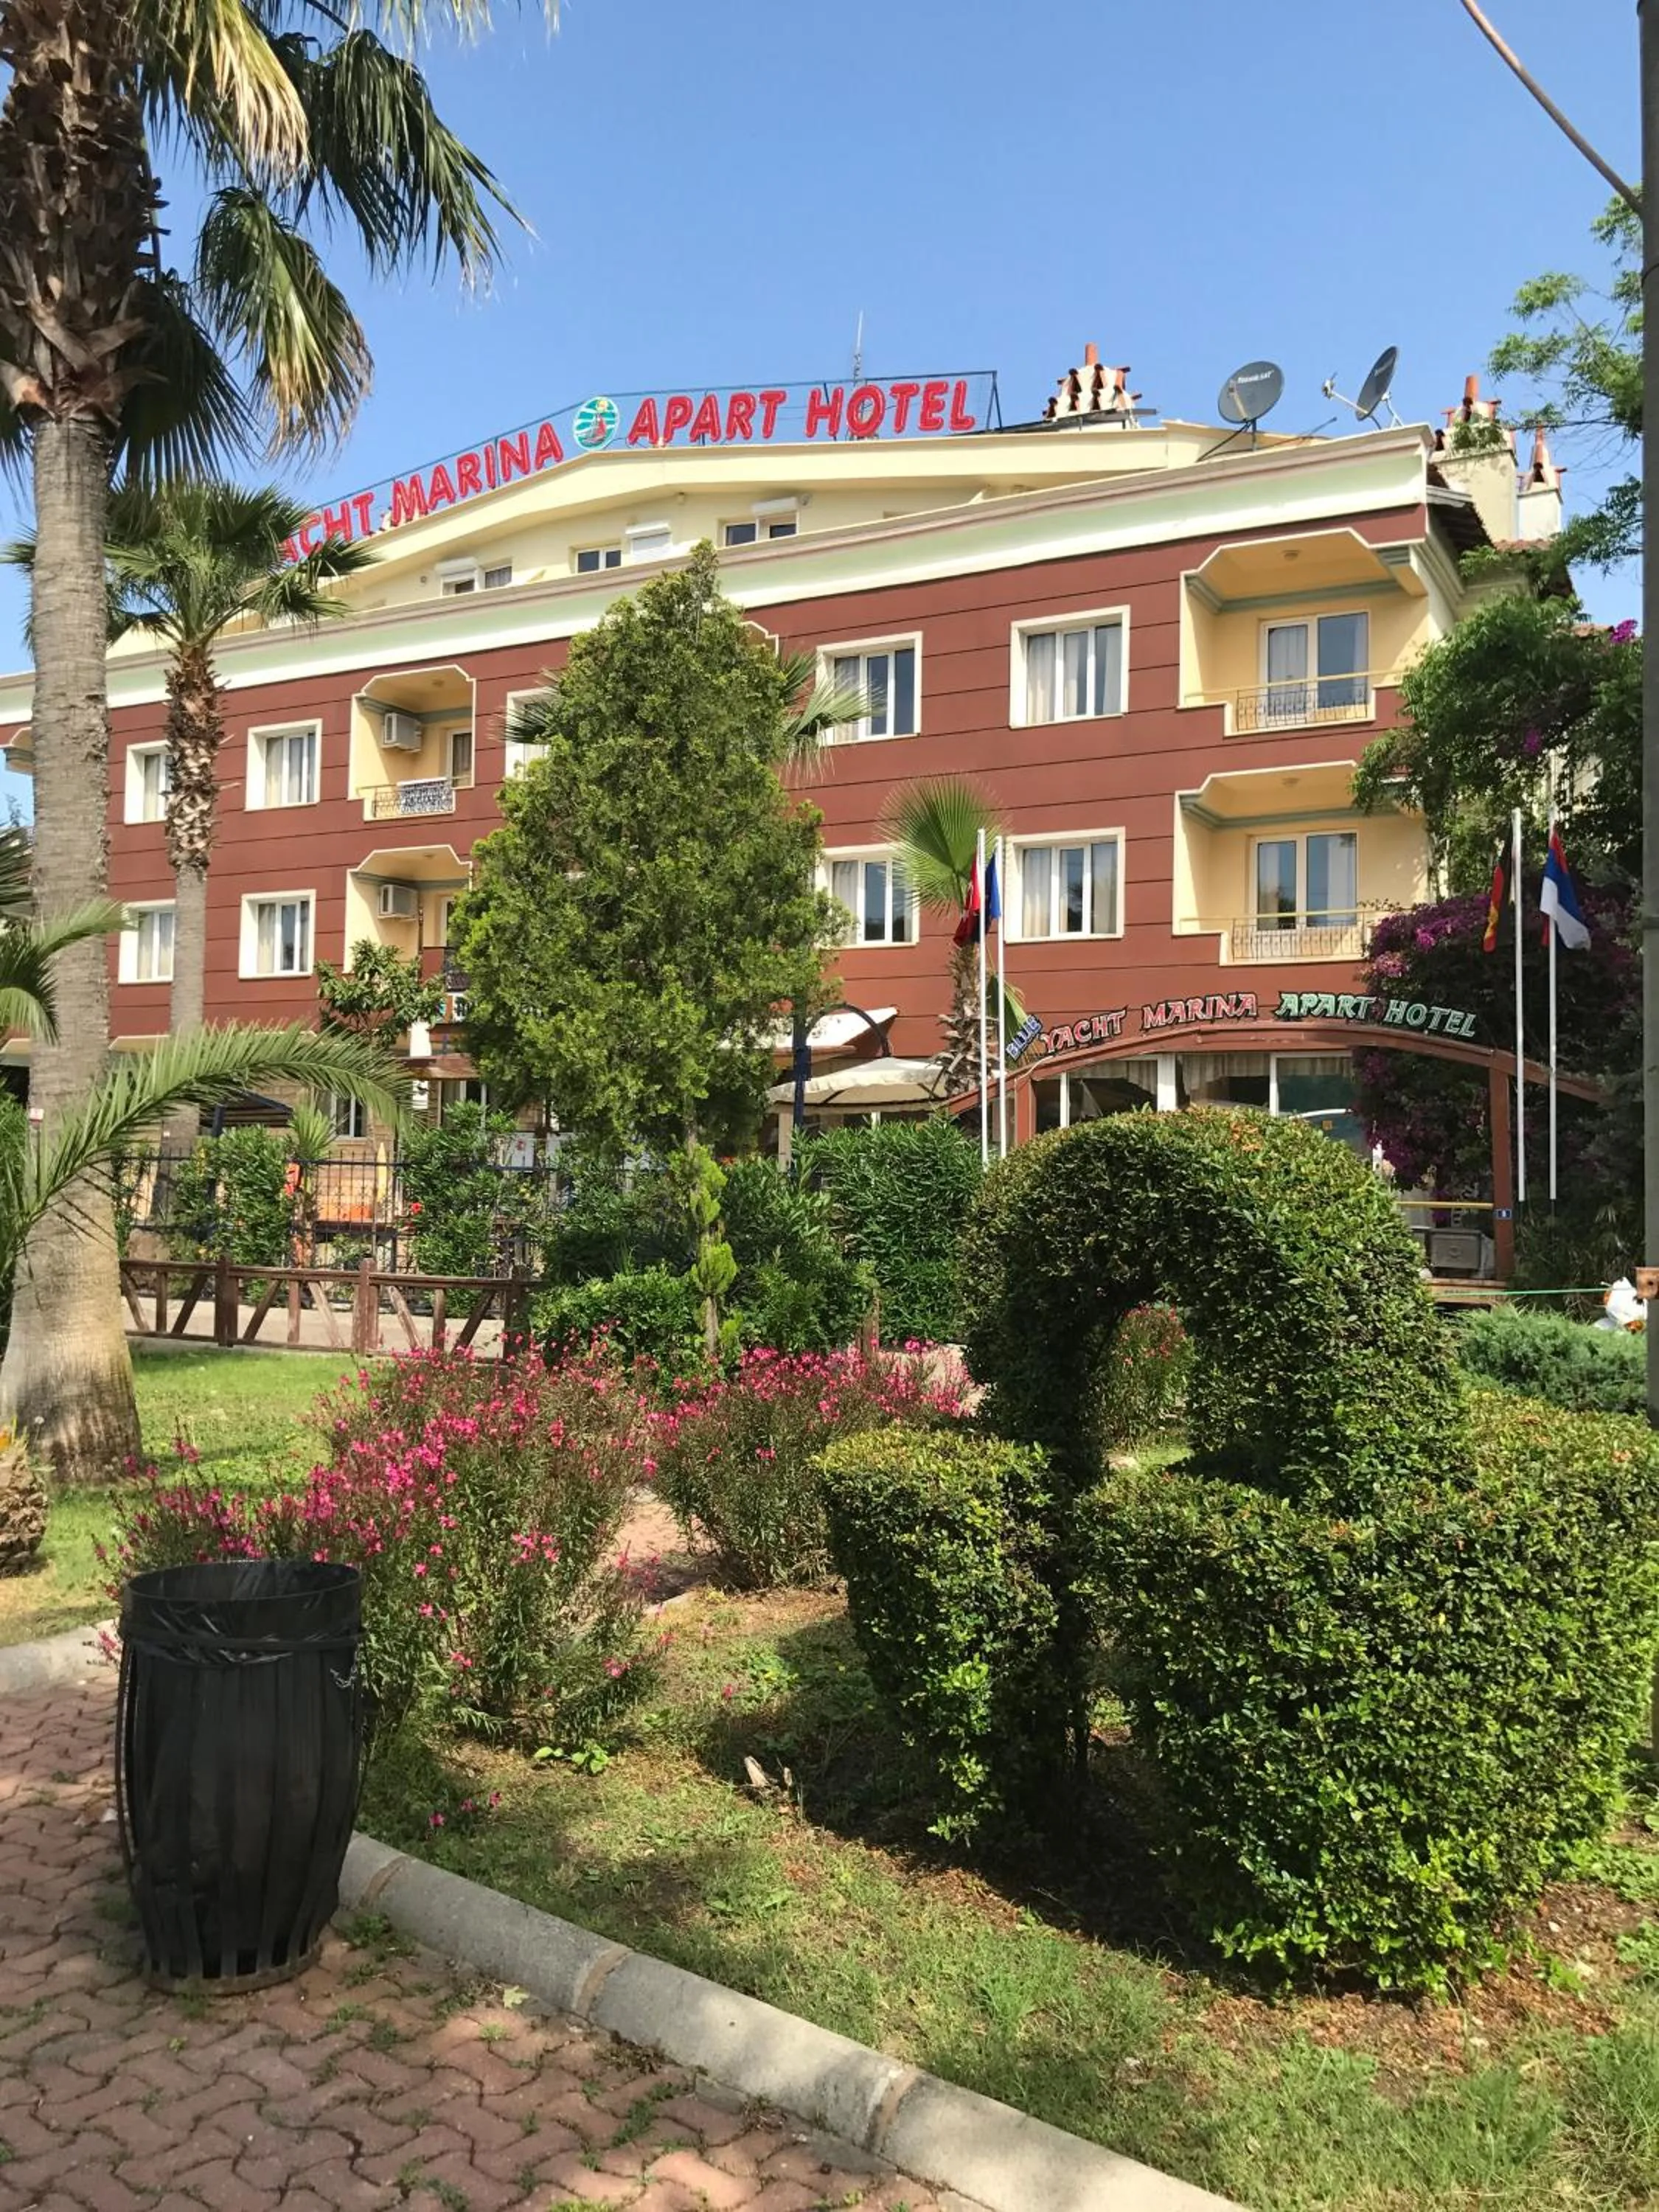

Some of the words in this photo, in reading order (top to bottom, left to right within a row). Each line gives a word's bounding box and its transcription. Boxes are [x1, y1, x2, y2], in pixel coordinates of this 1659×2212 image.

[276, 491, 375, 562] ACHT
[390, 422, 565, 526] MARINA
[628, 390, 787, 446] APART
[804, 379, 976, 439] HOTEL
[1005, 1014, 1043, 1060] BLUE
[1040, 1008, 1127, 1054] YACHT
[1142, 992, 1258, 1029] MARINA
[1275, 992, 1377, 1020] APART
[1382, 998, 1477, 1038] HOTEL
